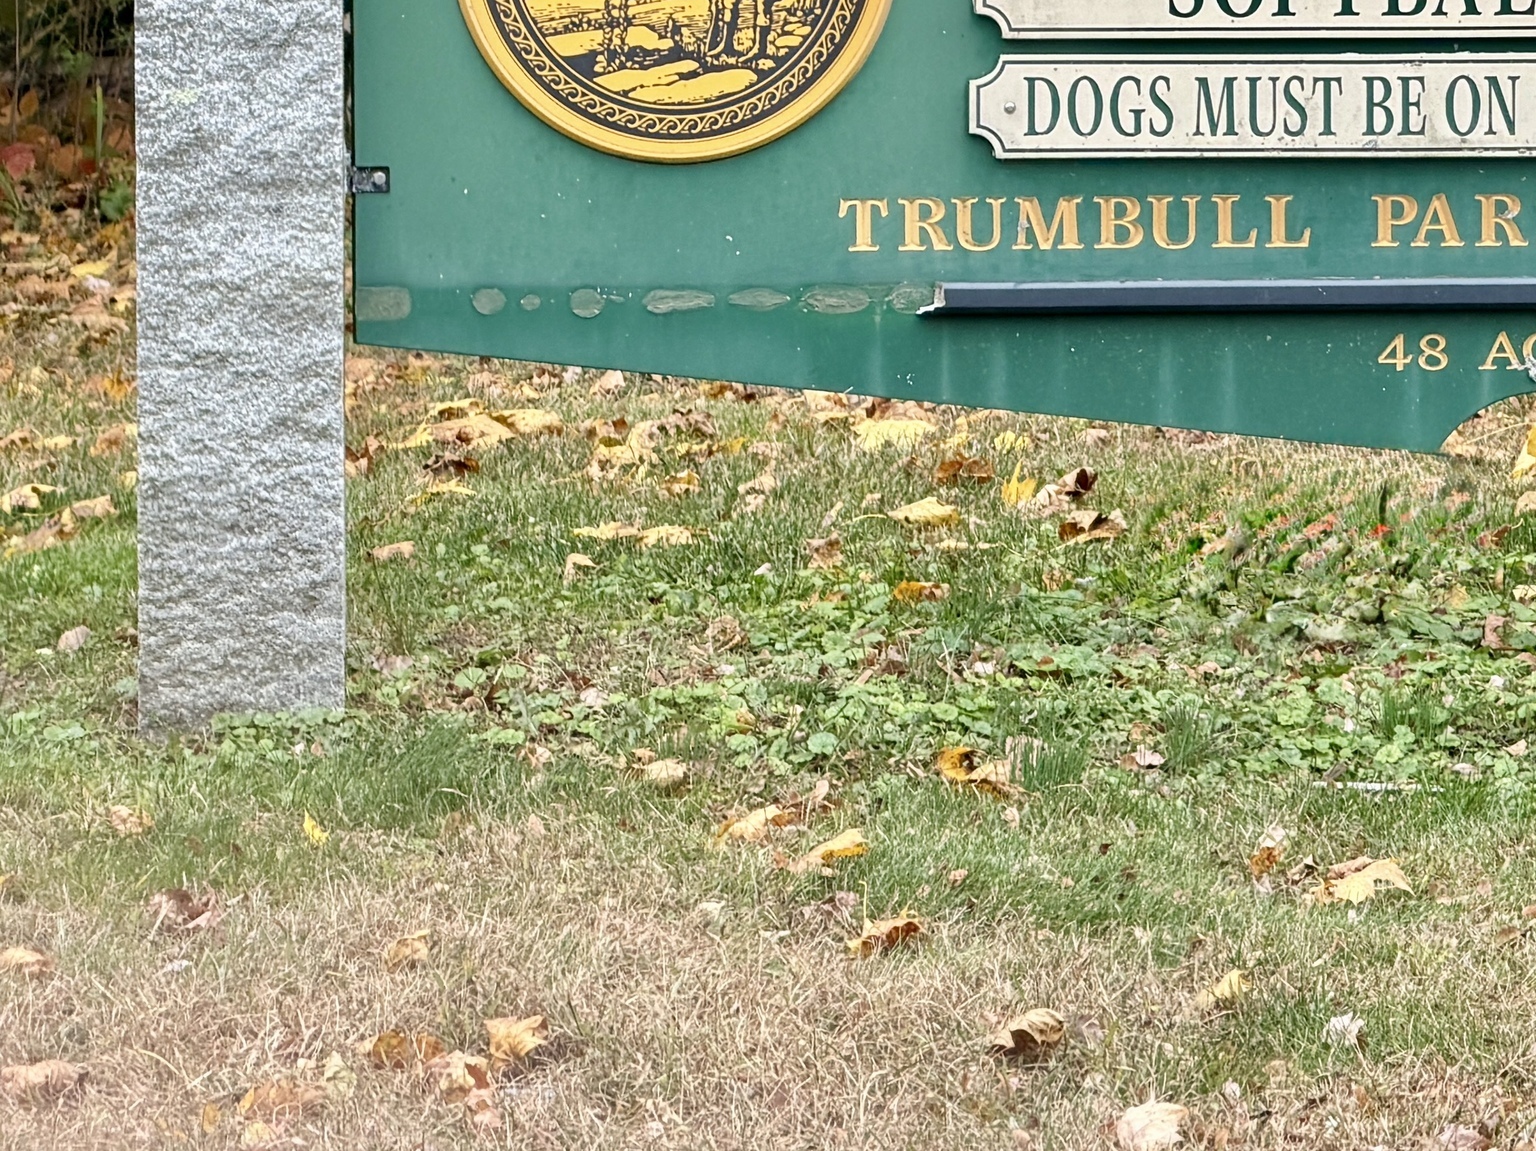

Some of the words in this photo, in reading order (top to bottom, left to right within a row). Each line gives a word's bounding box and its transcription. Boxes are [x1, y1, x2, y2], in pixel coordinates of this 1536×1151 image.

[1023, 75, 1175, 138] DOGS
[1192, 75, 1344, 138] MUST
[1362, 76, 1428, 137] BE
[1444, 74, 1521, 137] ON
[838, 194, 1311, 252] TRUMBULL
[1377, 332, 1450, 373] 48
